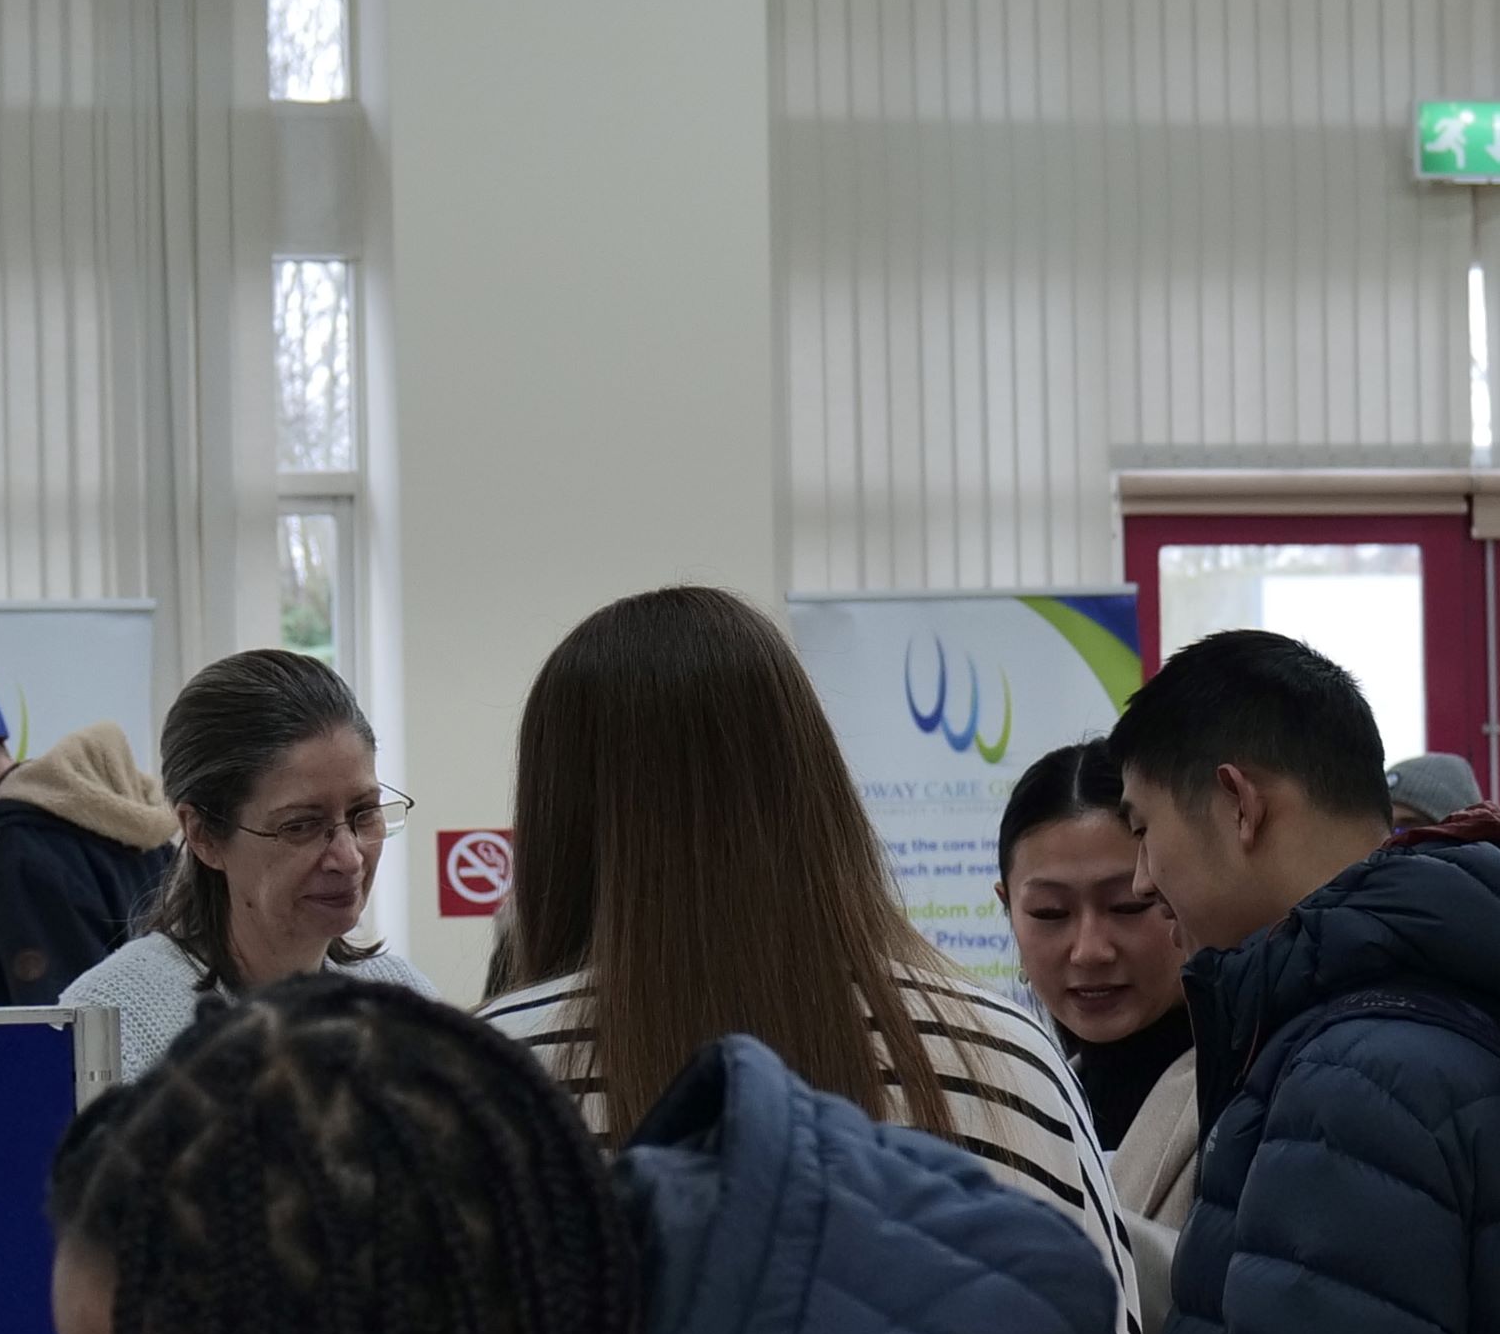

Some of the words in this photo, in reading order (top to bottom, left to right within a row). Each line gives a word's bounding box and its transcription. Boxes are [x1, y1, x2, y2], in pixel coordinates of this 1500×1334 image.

[924, 780, 981, 798] CARE
[911, 838, 937, 852] the
[932, 862, 962, 877] and
[975, 900, 997, 918] of
[936, 930, 1009, 952] Privacy
